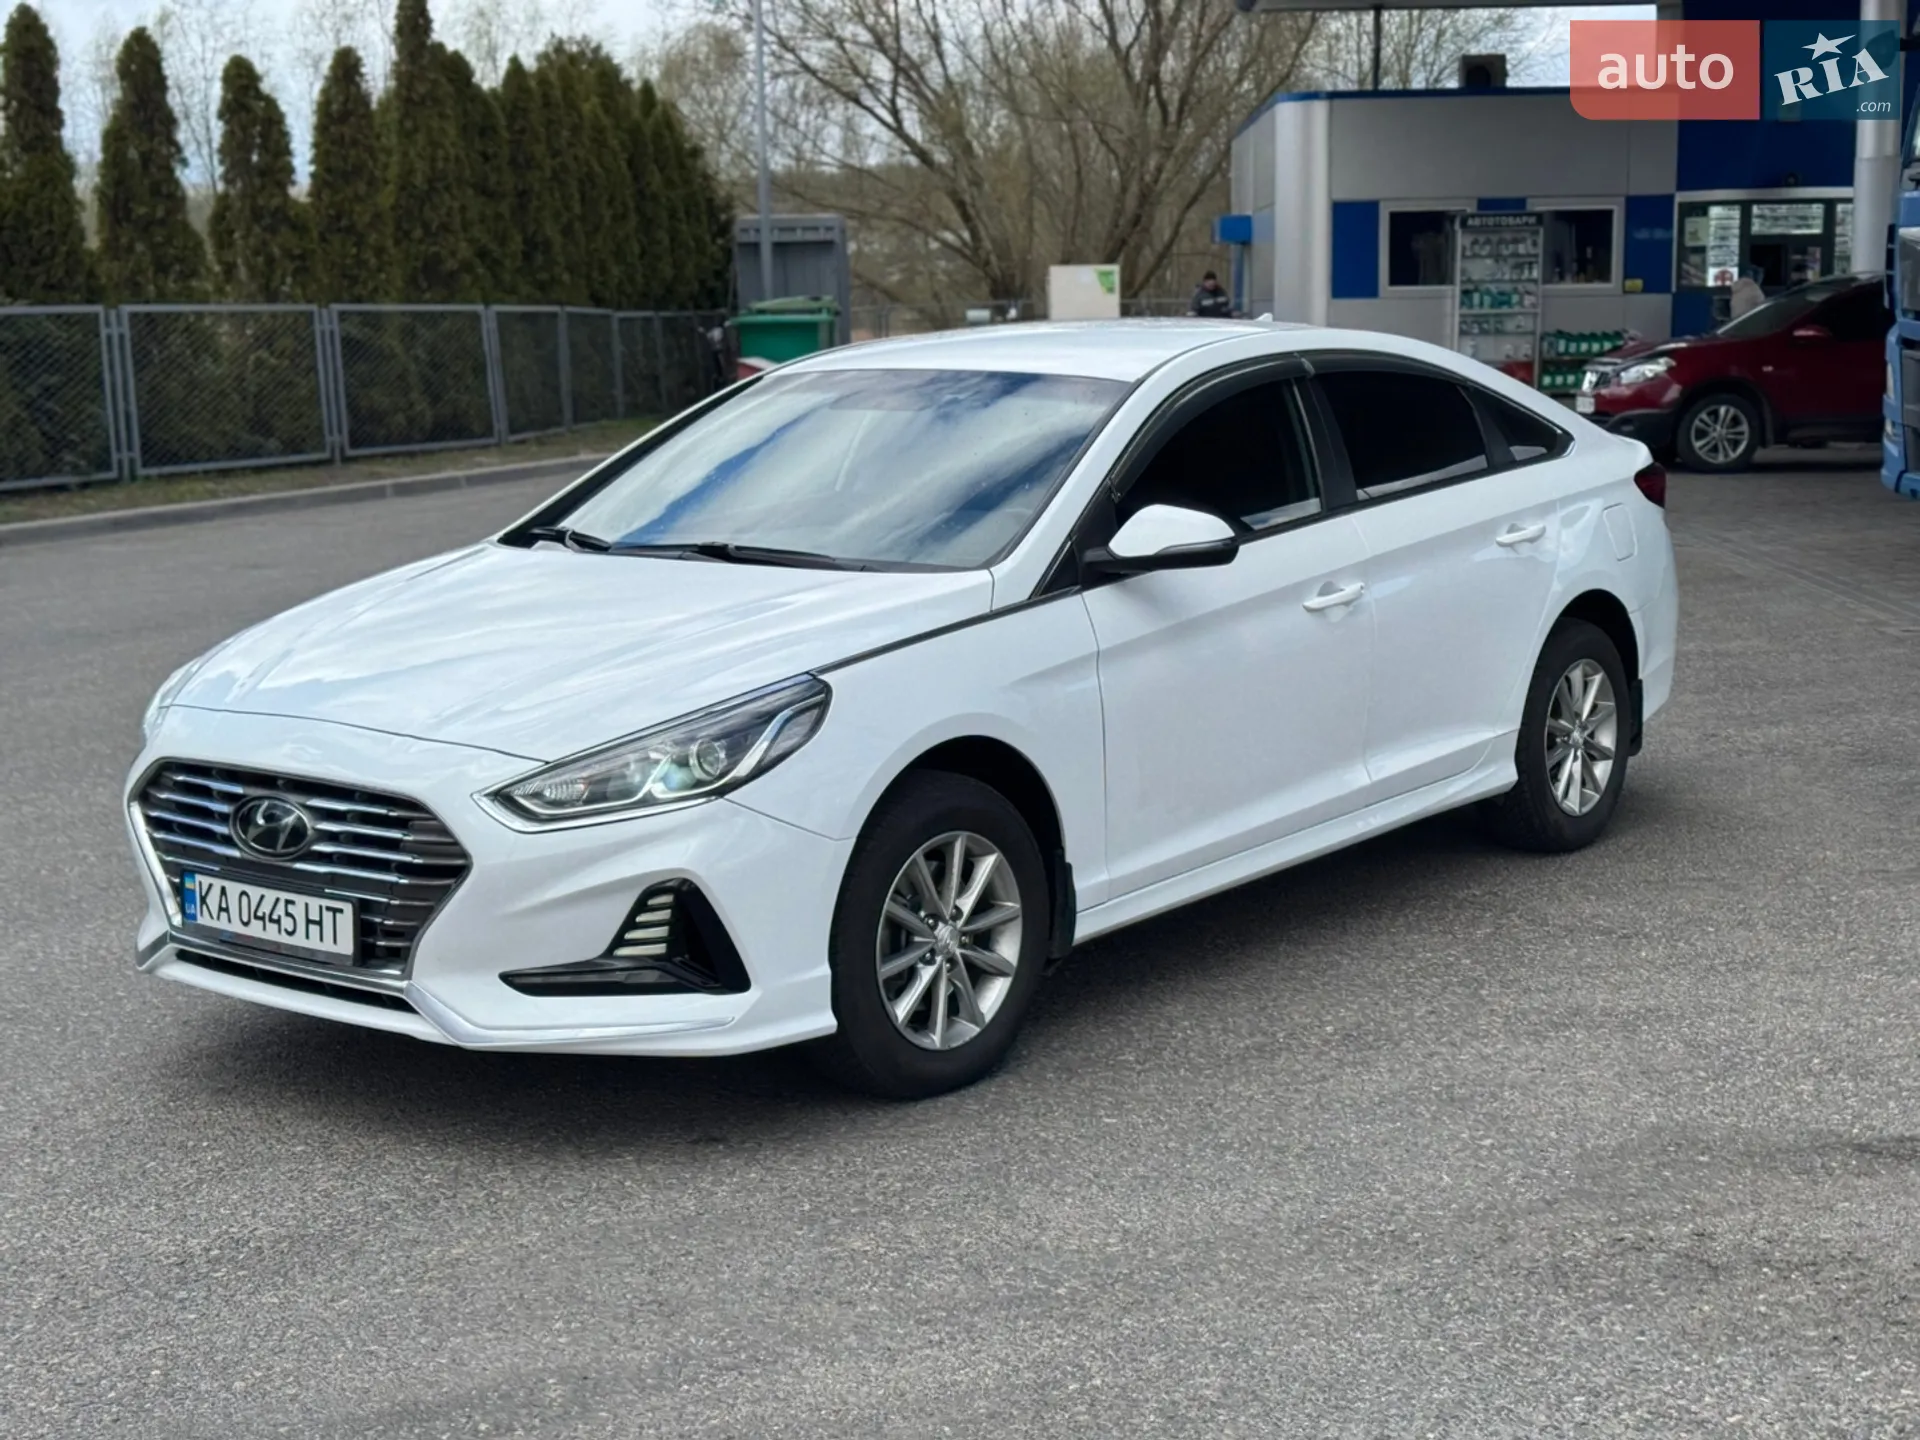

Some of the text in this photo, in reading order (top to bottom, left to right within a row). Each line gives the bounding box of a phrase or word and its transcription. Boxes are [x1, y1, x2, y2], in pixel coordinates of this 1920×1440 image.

[185, 903, 195, 915] UA
[198, 880, 344, 946] KA 0445 HT
